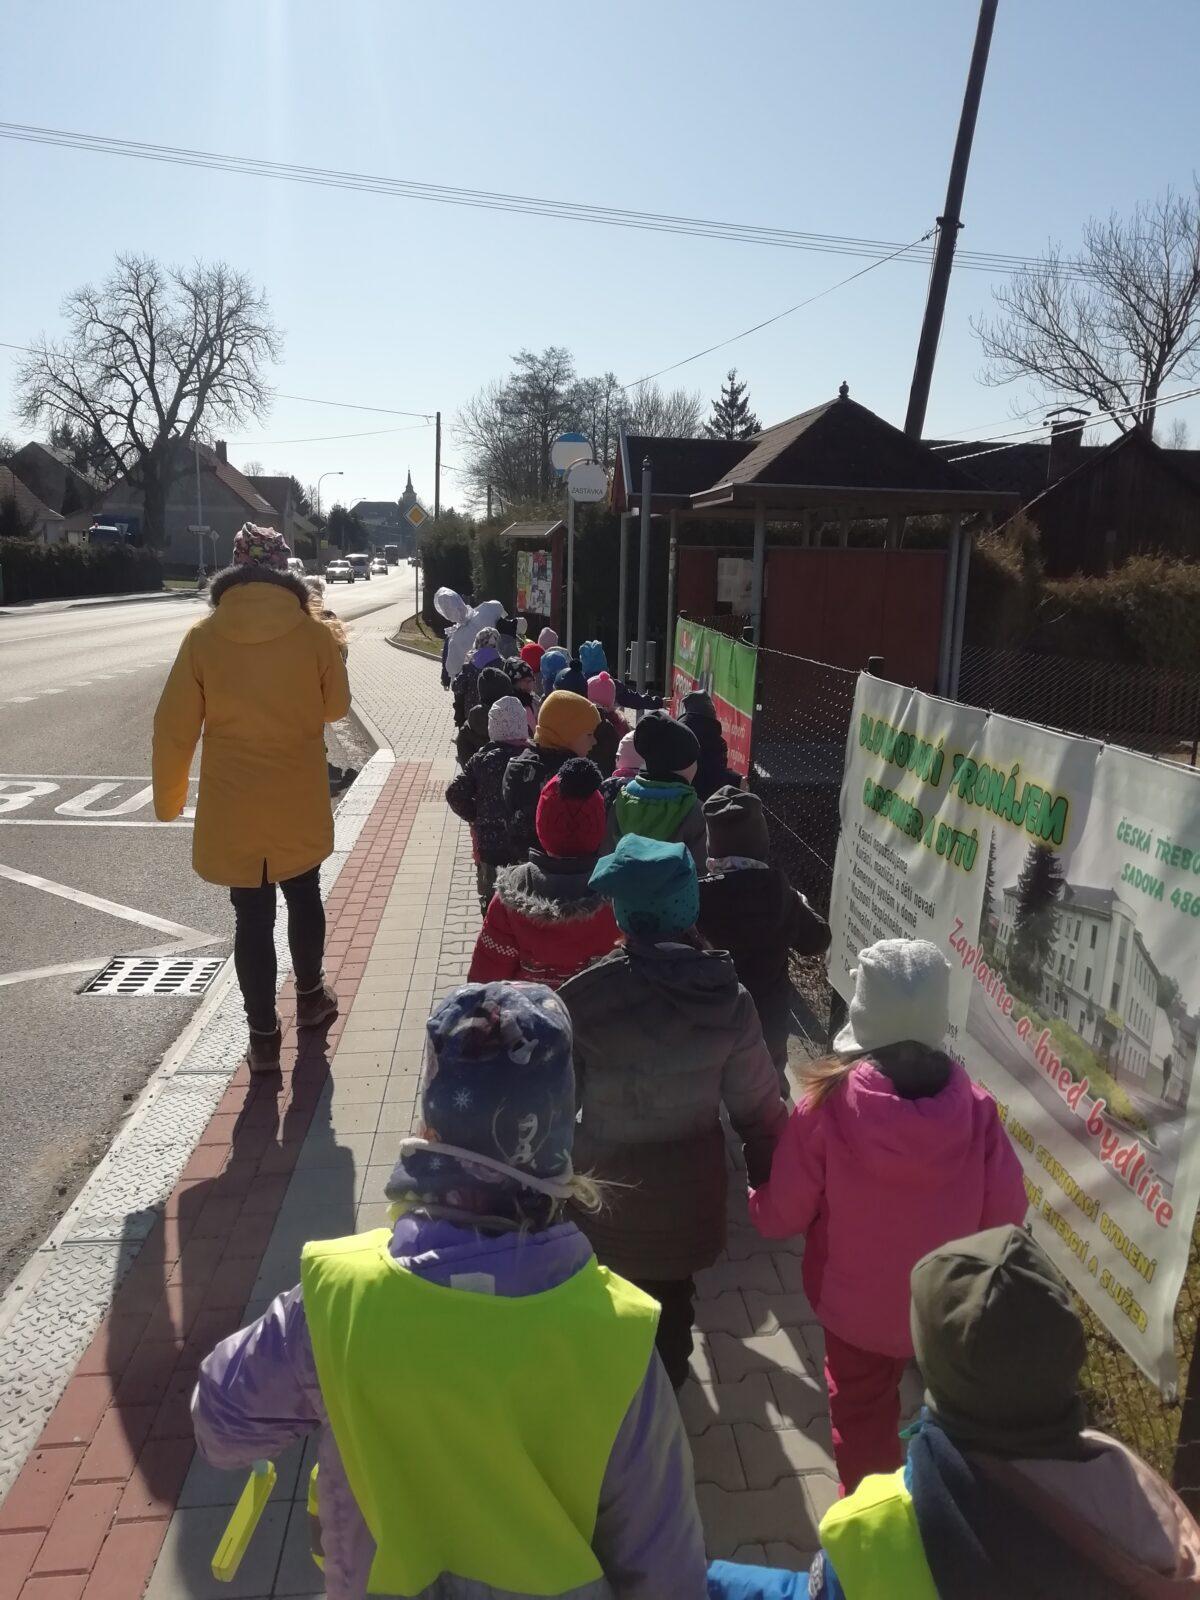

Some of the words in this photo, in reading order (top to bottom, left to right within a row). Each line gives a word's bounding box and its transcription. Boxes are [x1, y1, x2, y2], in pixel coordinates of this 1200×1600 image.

[0, 780, 197, 818] BU
[936, 822, 979, 872] BYTŮ
[1117, 816, 1154, 855] ČESKÁ
[1034, 1030, 1090, 1113] hned
